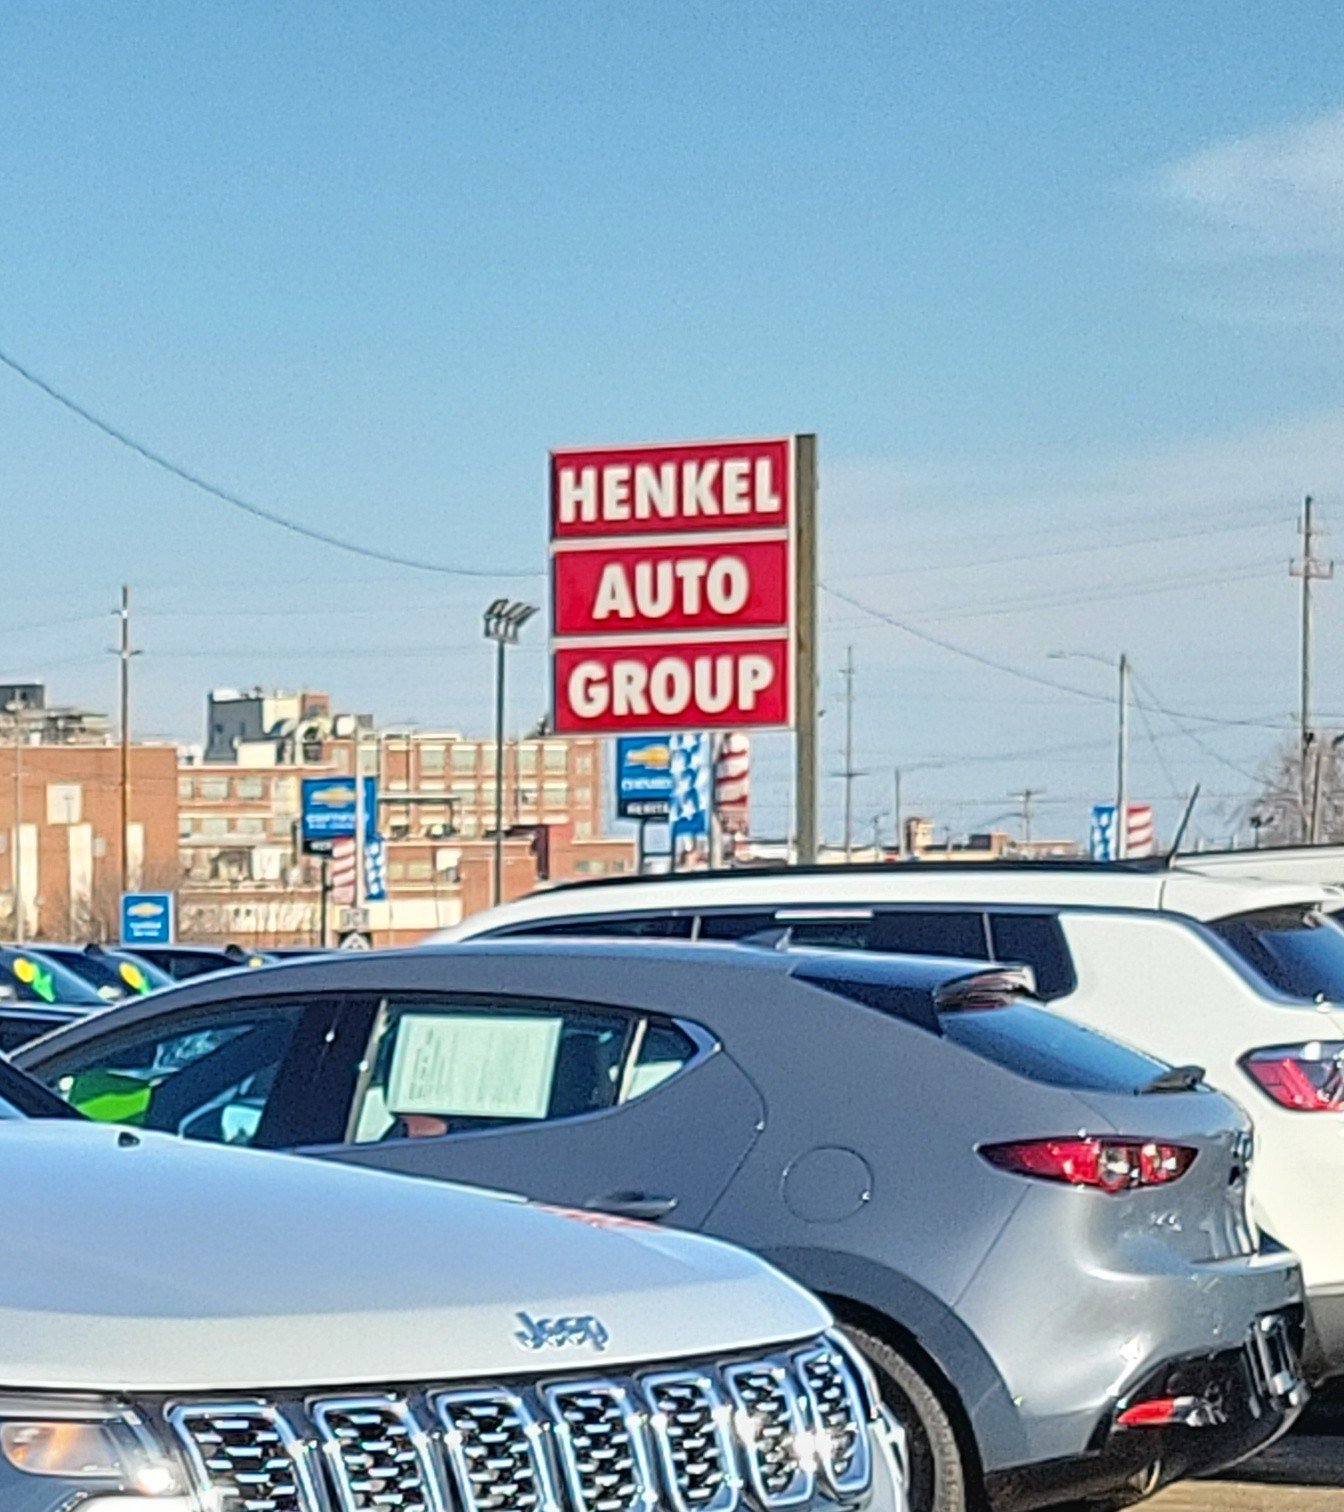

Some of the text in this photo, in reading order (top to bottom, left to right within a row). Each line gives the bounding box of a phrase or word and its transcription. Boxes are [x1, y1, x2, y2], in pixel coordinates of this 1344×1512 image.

[558, 455, 782, 524] HENKEL
[591, 555, 750, 620] AUTO
[567, 654, 775, 719] GROUP
[514, 1310, 609, 1351] Jeep
